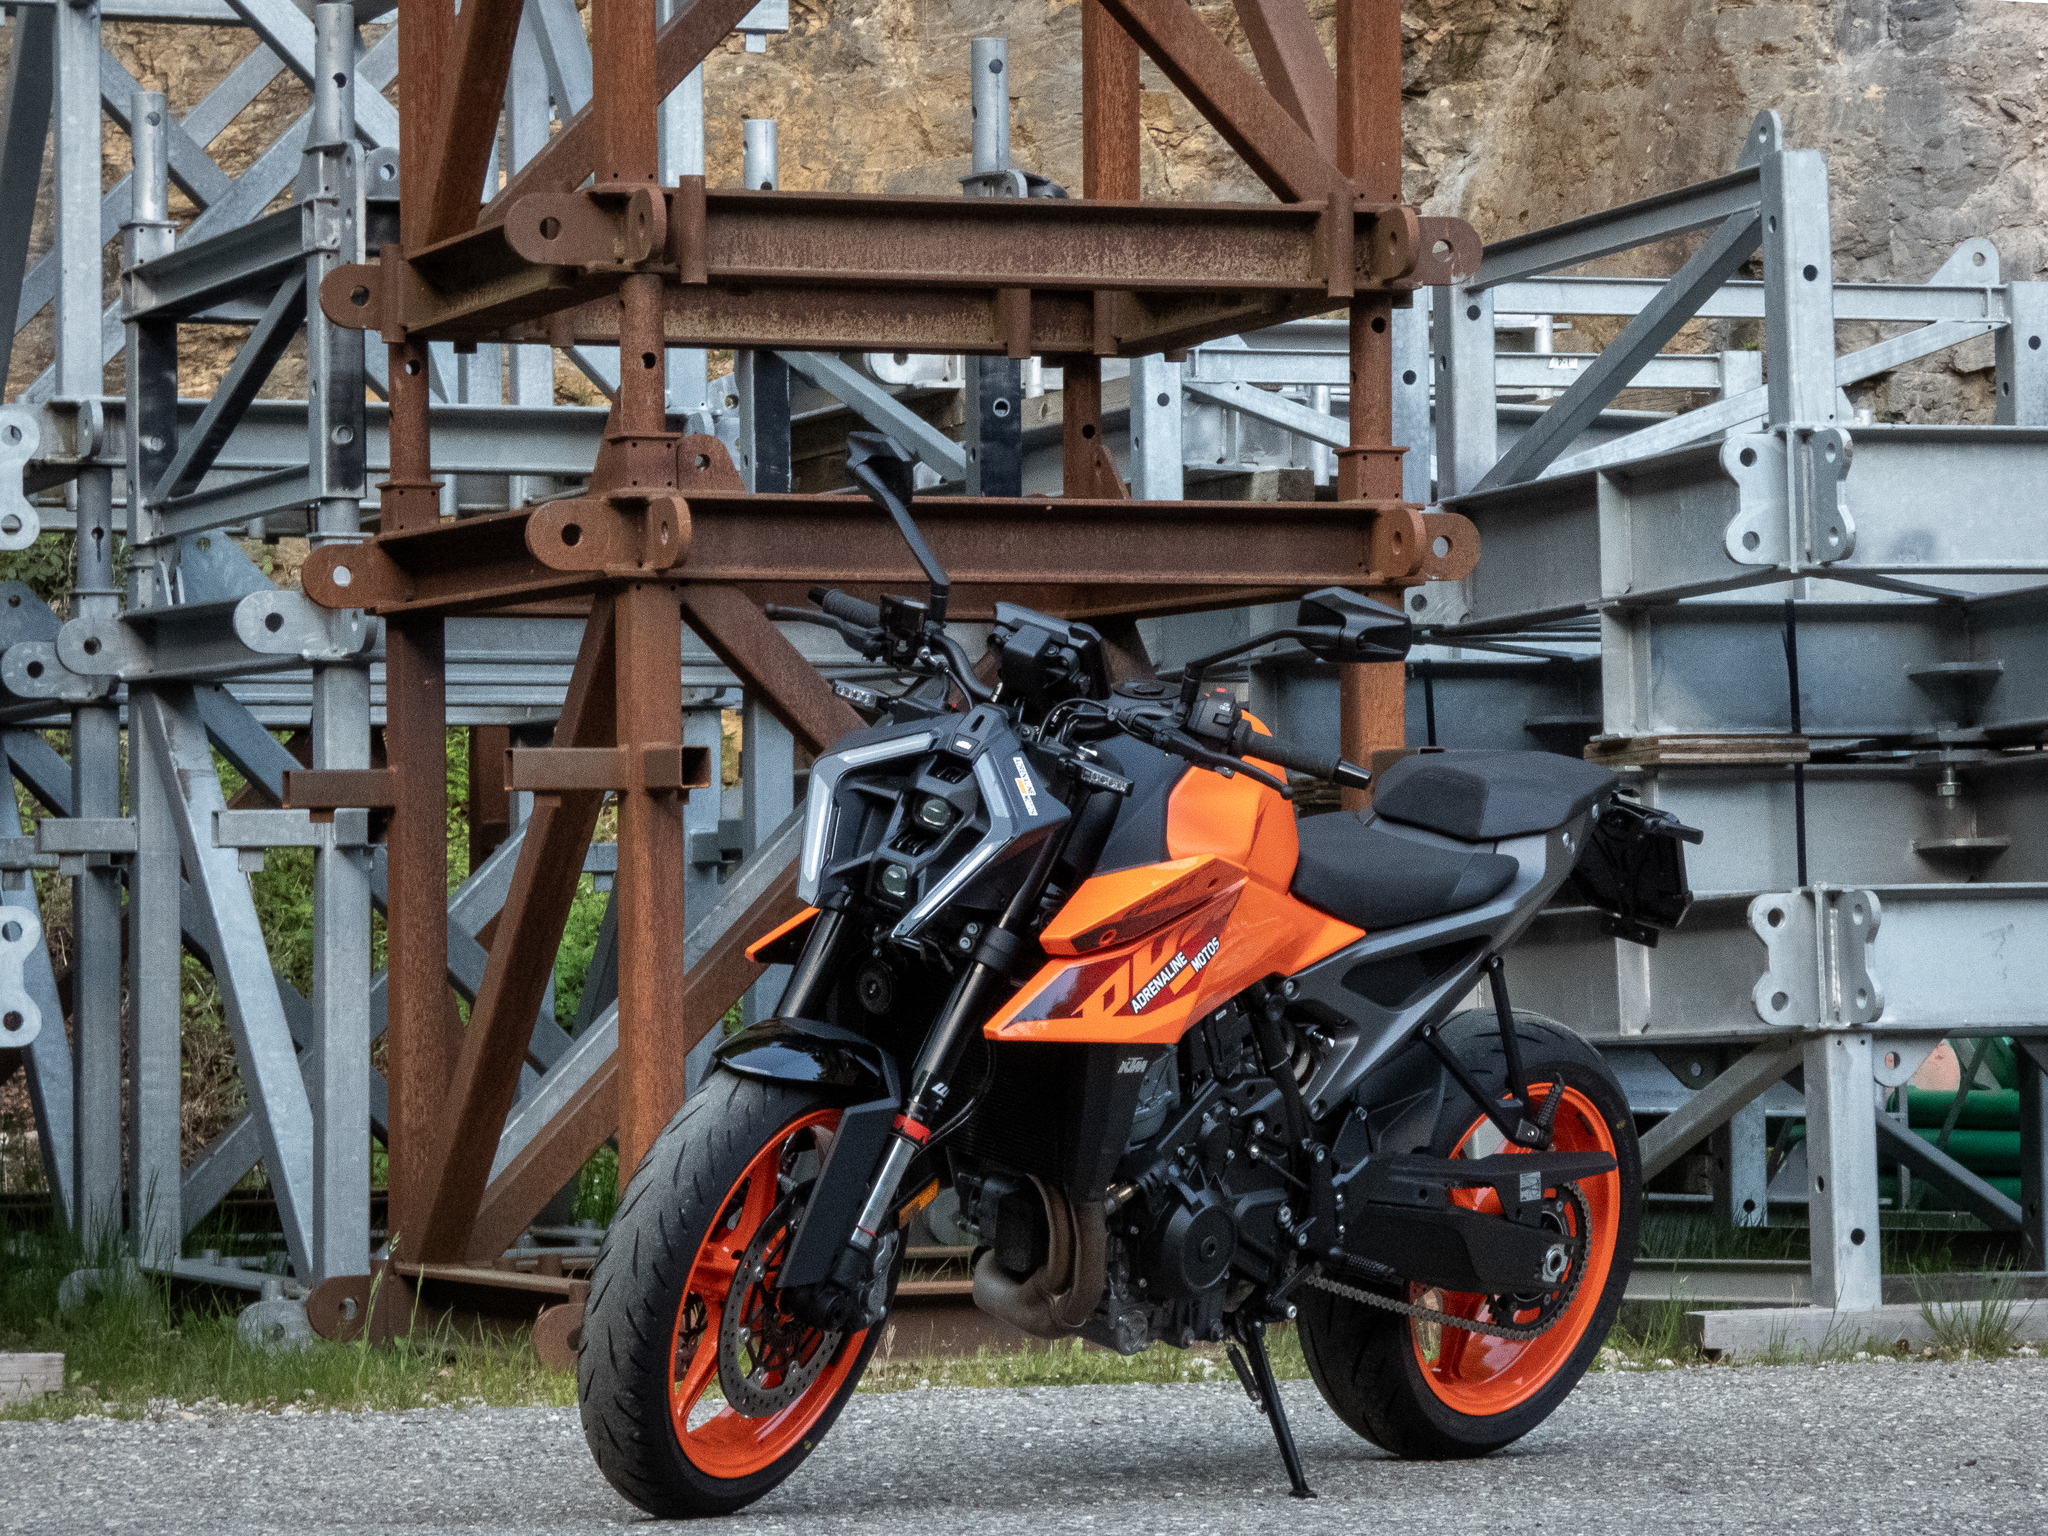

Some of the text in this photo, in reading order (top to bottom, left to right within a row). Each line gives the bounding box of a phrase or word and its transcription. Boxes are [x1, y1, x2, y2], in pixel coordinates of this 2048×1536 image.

[1190, 936, 1220, 972] MOTOS
[1131, 951, 1188, 1015] ADRENALINE
[1117, 1057, 1149, 1074] KTM
